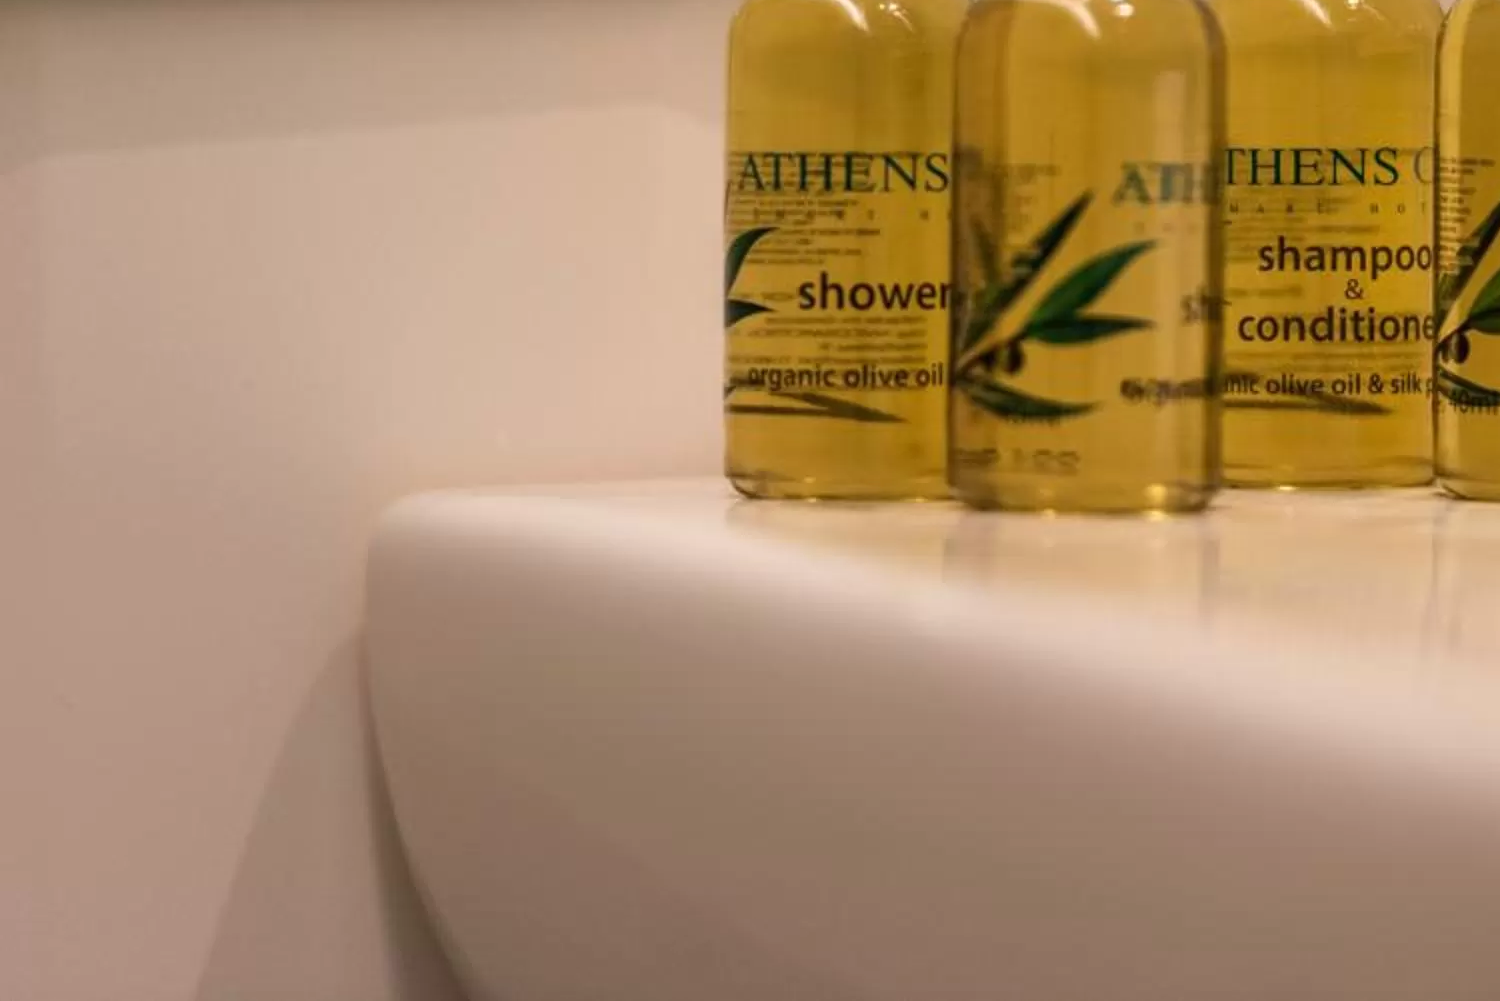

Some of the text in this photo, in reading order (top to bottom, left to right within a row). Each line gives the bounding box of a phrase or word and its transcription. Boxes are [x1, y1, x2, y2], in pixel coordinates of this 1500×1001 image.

[738, 152, 949, 193] ATHENS
[1257, 235, 1433, 280] shampoo
[1344, 279, 1363, 300] &
[747, 364, 945, 393] organic olive oil
[1265, 374, 1325, 397] olive
[1331, 373, 1361, 396] oil
[1367, 374, 1384, 396] &
[1391, 372, 1422, 396] silk
